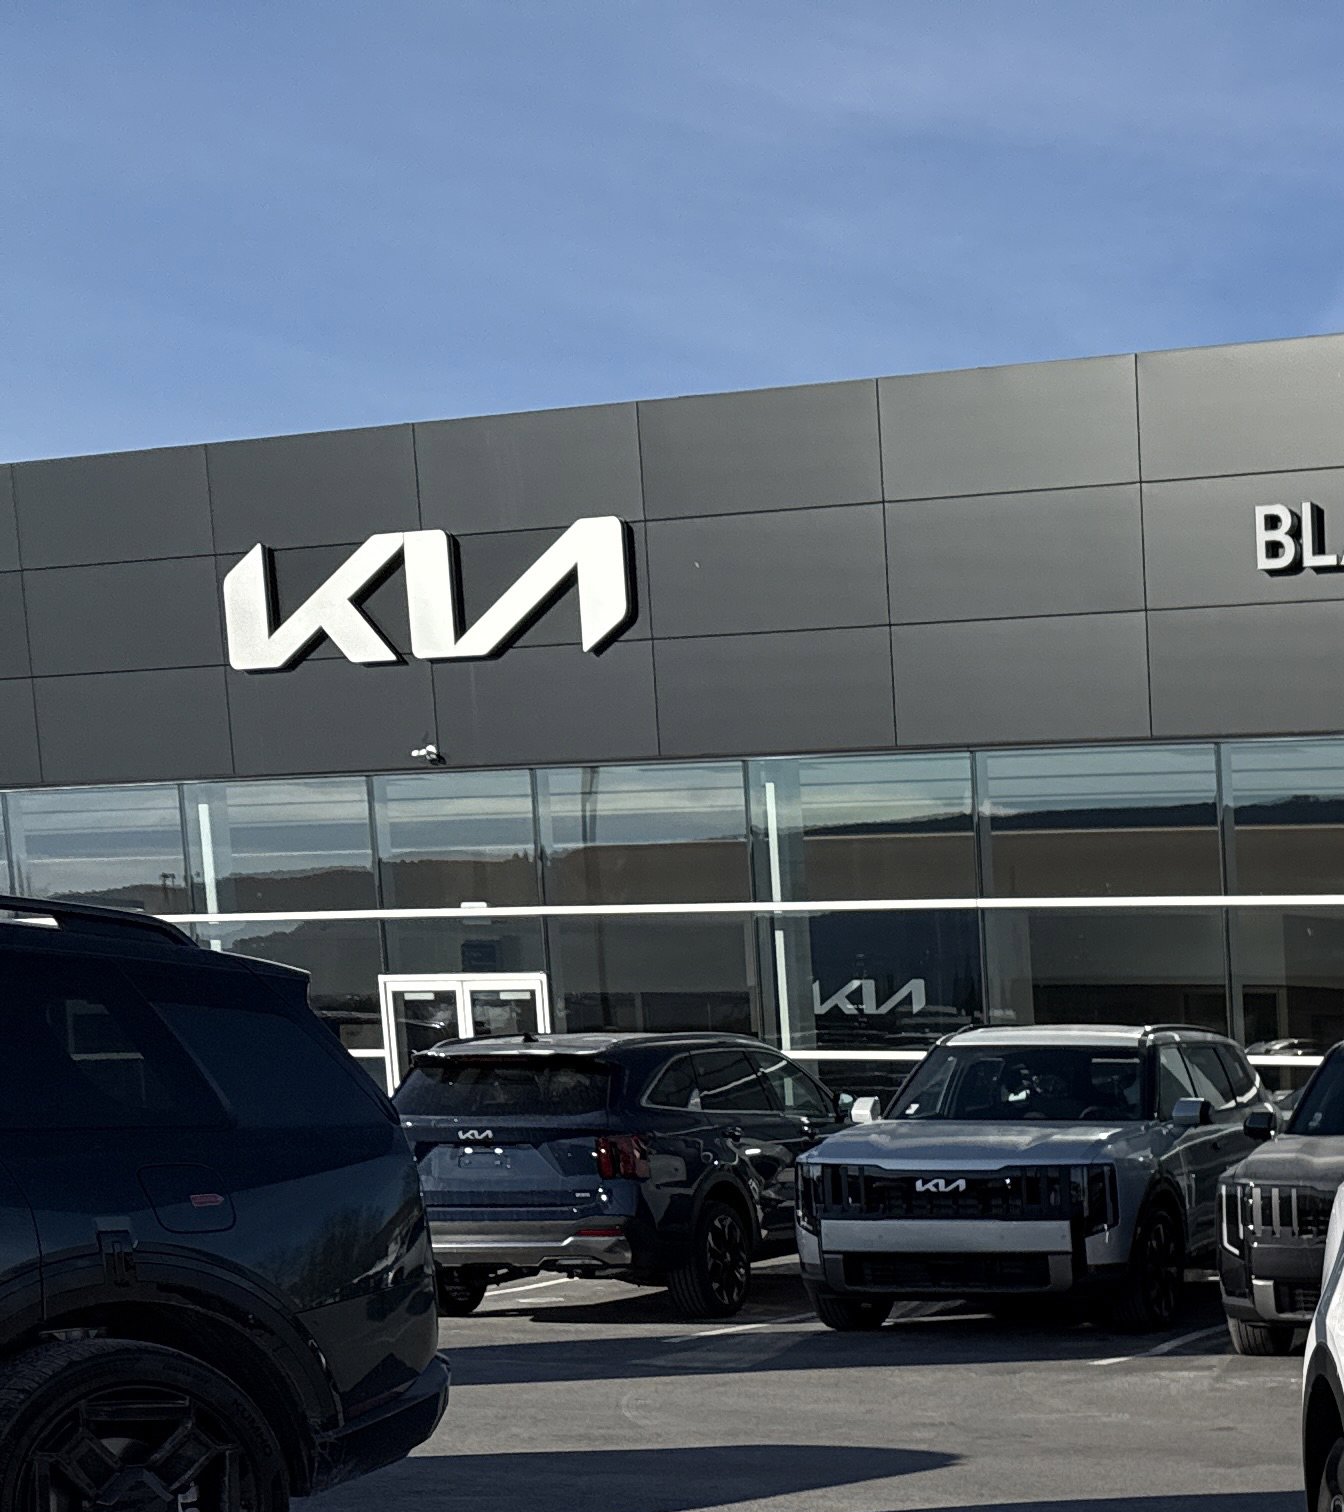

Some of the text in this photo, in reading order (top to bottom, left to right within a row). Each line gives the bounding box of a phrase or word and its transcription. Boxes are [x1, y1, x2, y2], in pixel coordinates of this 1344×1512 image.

[223, 515, 634, 672] KIA
[812, 978, 926, 1015] KIA
[458, 1129, 494, 1140] KIA
[915, 1178, 966, 1193] KIA
